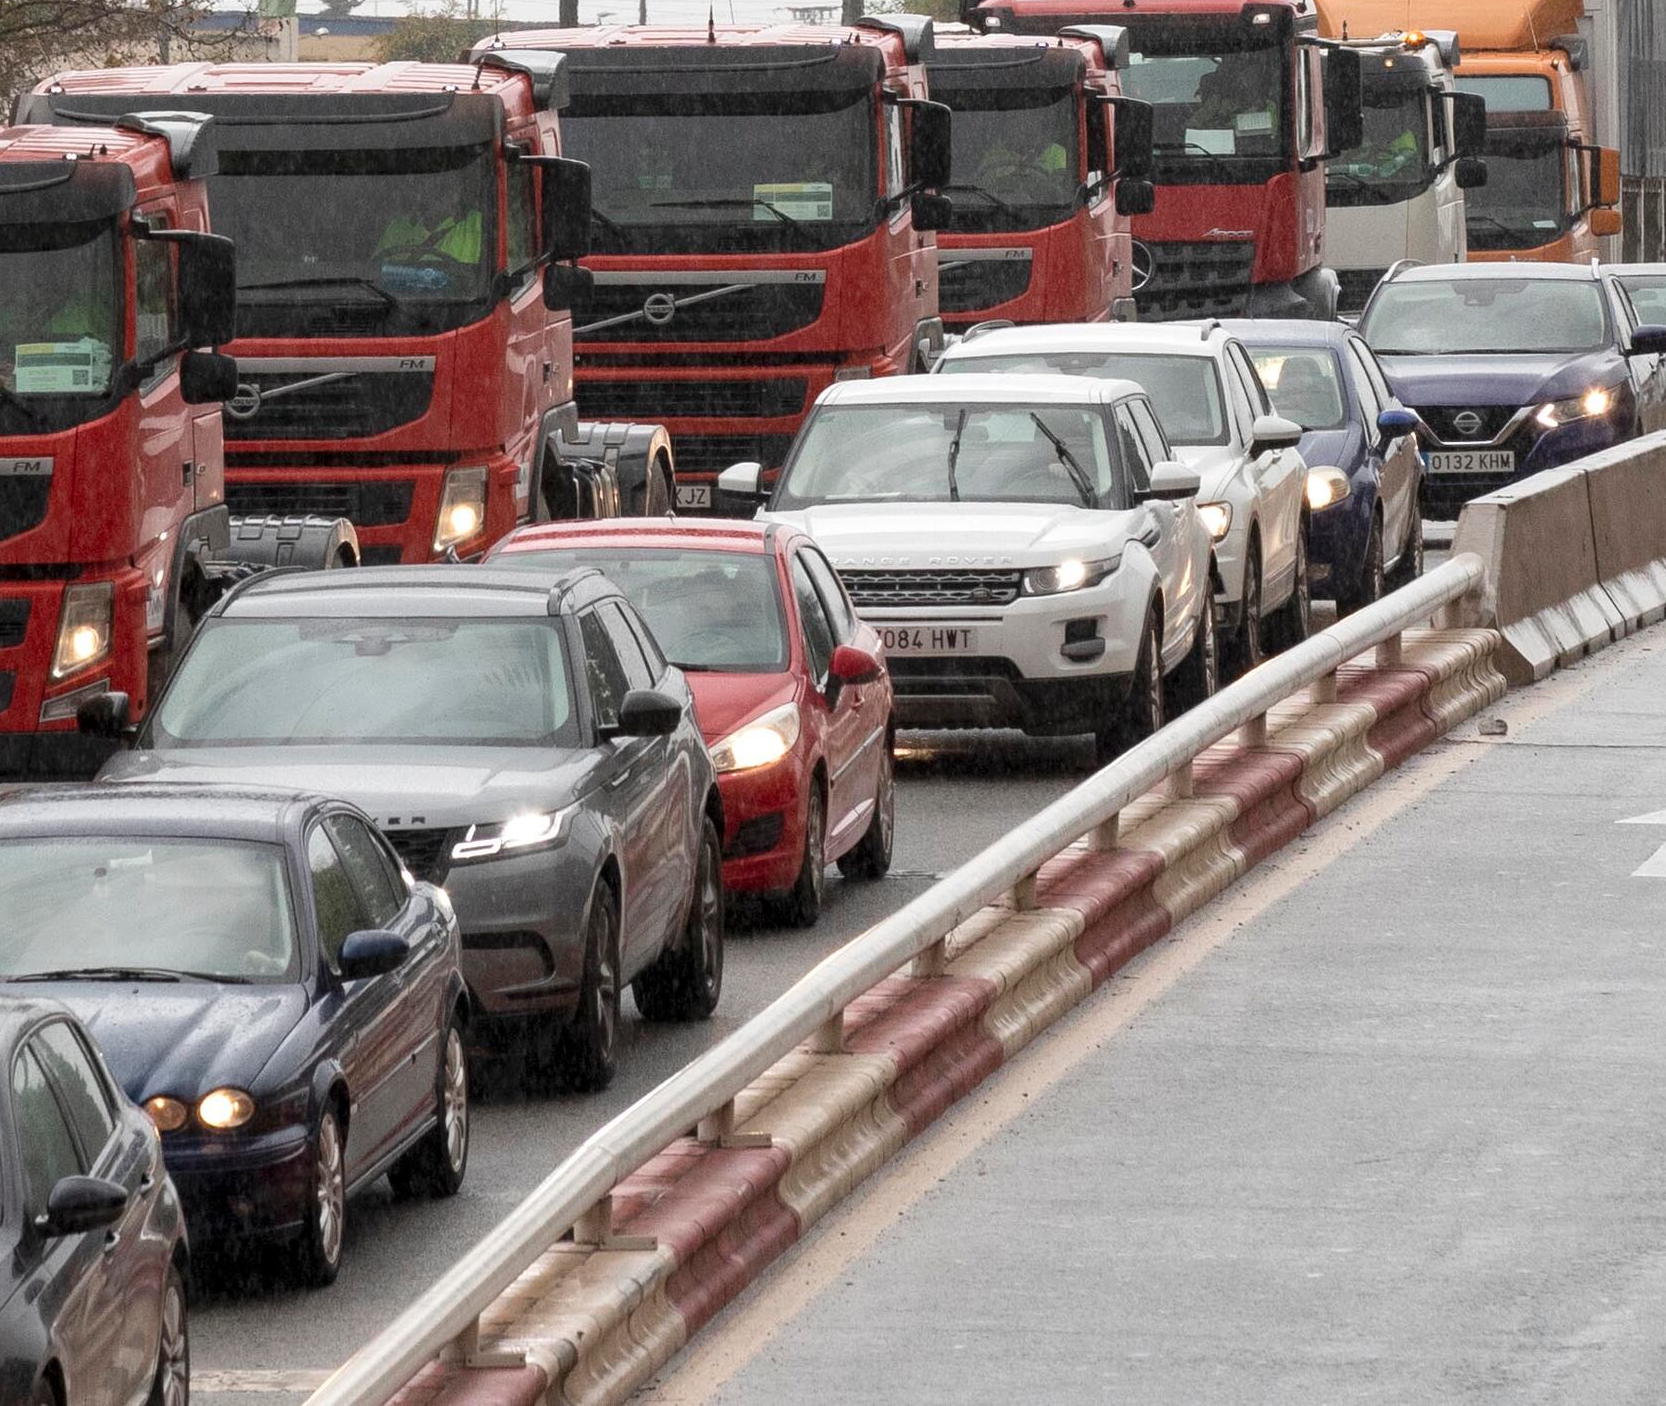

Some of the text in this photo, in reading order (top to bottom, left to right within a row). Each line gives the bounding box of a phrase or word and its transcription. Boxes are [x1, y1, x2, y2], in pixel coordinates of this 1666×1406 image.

[794, 273, 817, 282] FM
[399, 360, 425, 369] FM
[13, 461, 41, 473] FM
[1432, 454, 1511, 470] 0132 KHM
[929, 555, 1014, 566] ROVER
[932, 629, 972, 650] HWT
